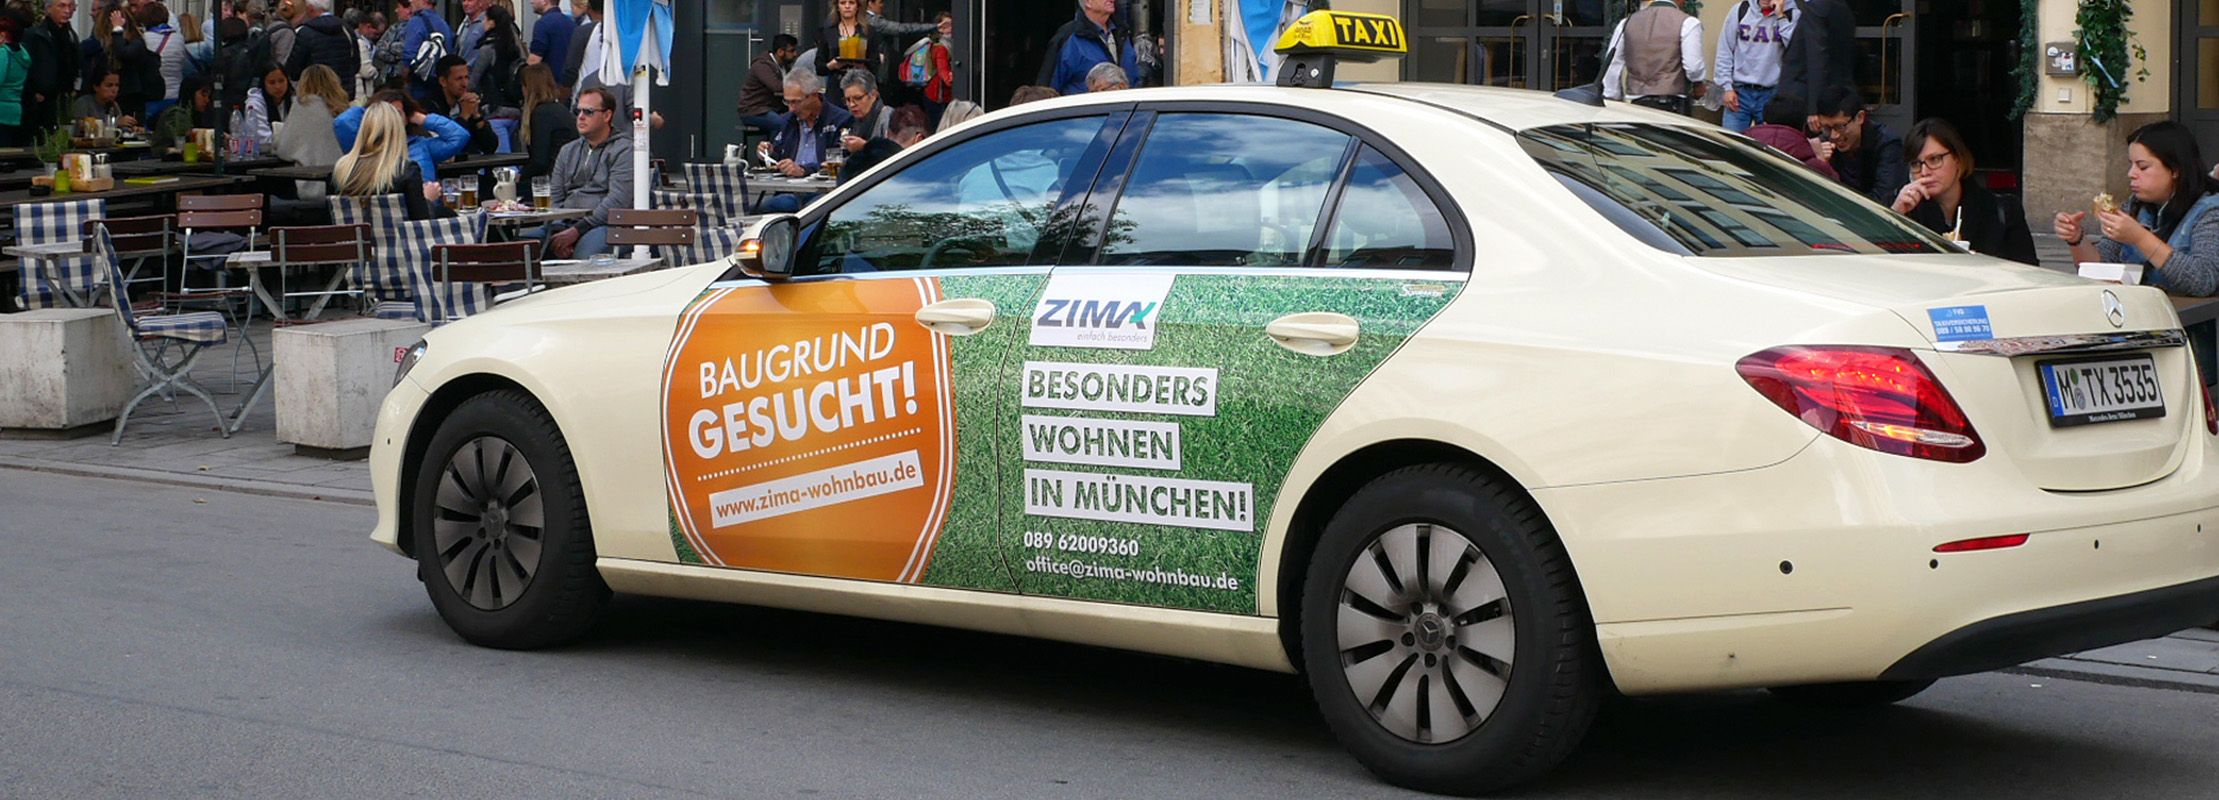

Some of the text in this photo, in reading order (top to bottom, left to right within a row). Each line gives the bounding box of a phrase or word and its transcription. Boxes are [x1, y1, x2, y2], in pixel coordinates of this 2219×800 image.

[1335, 16, 1398, 46] TAXI
[1037, 299, 1157, 330] ZIMA
[1077, 331, 1148, 343] einfach besonders
[700, 322, 895, 399] BAUGRUND
[1028, 370, 1209, 406] BESONDERS
[2056, 364, 2158, 409] M TX 3535
[688, 360, 918, 459] GESUCHT!
[1029, 423, 1173, 460] WOHNEN
[716, 460, 917, 518] www.zima-wohnbau.de
[1031, 475, 1247, 522] IN MÜNCHEN!
[1024, 531, 1139, 556] 089 62009360
[1026, 556, 1239, 590] office@zima-wohnbau.de
